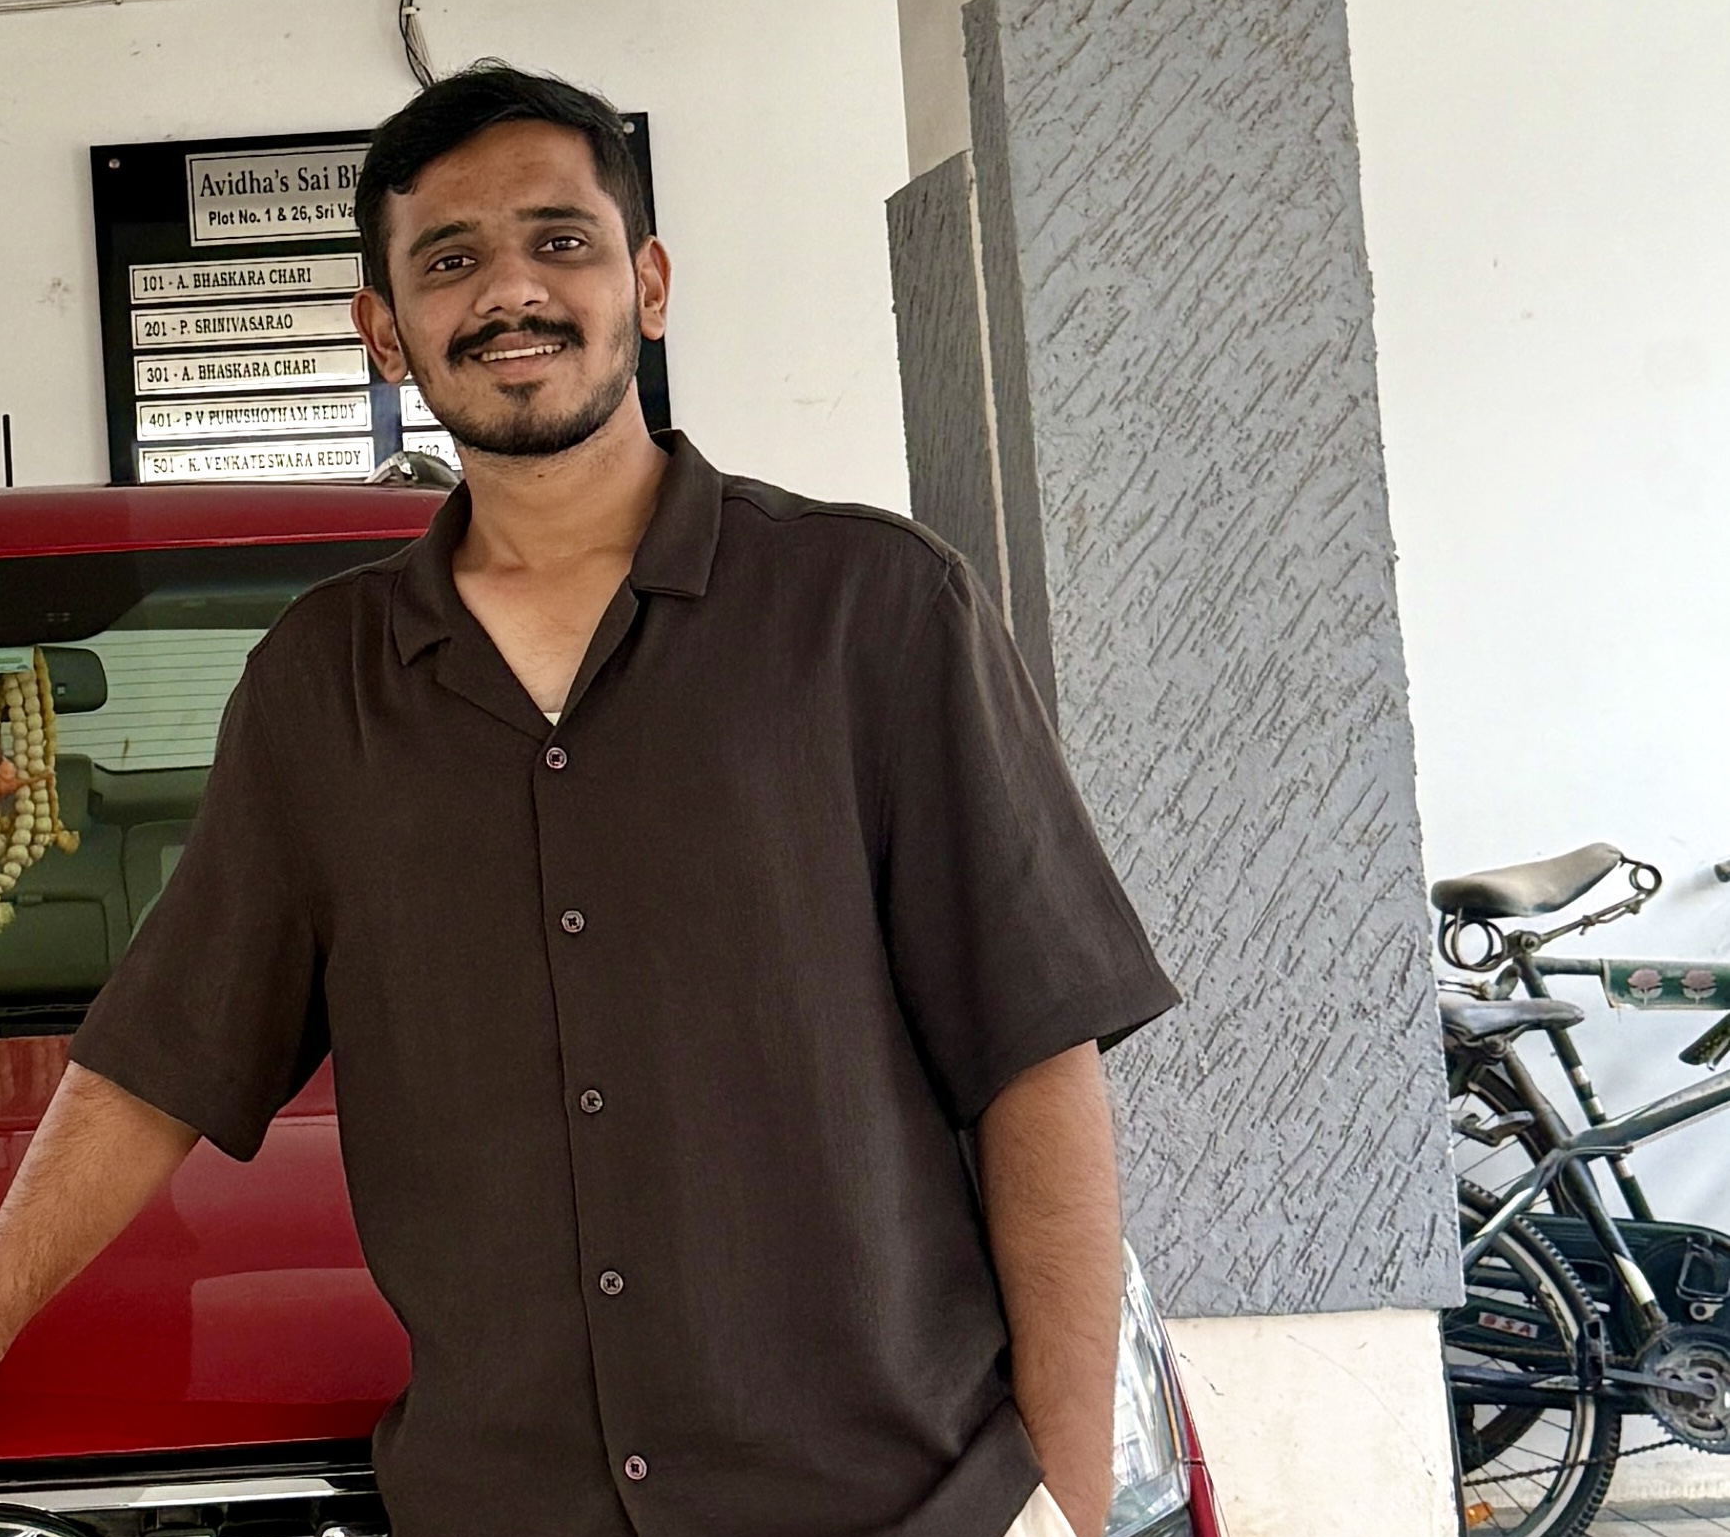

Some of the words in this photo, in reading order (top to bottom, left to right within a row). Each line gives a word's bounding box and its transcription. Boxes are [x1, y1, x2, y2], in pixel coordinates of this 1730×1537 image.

[199, 169, 290, 197] Avidha's
[297, 166, 330, 192] Sai
[209, 210, 235, 226] Plot
[239, 208, 261, 225] No.
[264, 208, 271, 222] 1
[277, 206, 287, 221] &
[291, 205, 312, 224] 26,
[315, 203, 334, 220] Sri
[142, 275, 164, 292] 101
[176, 274, 189, 290] A.
[193, 270, 266, 289] BHASKARA
[269, 267, 312, 285] CHARI
[144, 321, 168, 337] 201
[180, 319, 191, 335] P.
[195, 313, 294, 334] SRINIVASARAO
[146, 366, 169, 383] 301
[181, 365, 194, 382] A.
[198, 361, 271, 380] BHASKARA
[274, 358, 317, 376] CHARI
[149, 412, 172, 428] 401
[209, 405, 308, 426] PURUSHOTHAM
[312, 403, 357, 421] REDDY
[153, 457, 175, 474] 501
[188, 457, 201, 473] K.
[204, 453, 313, 471] VENKATESWARA
[317, 450, 362, 467] REDDY
